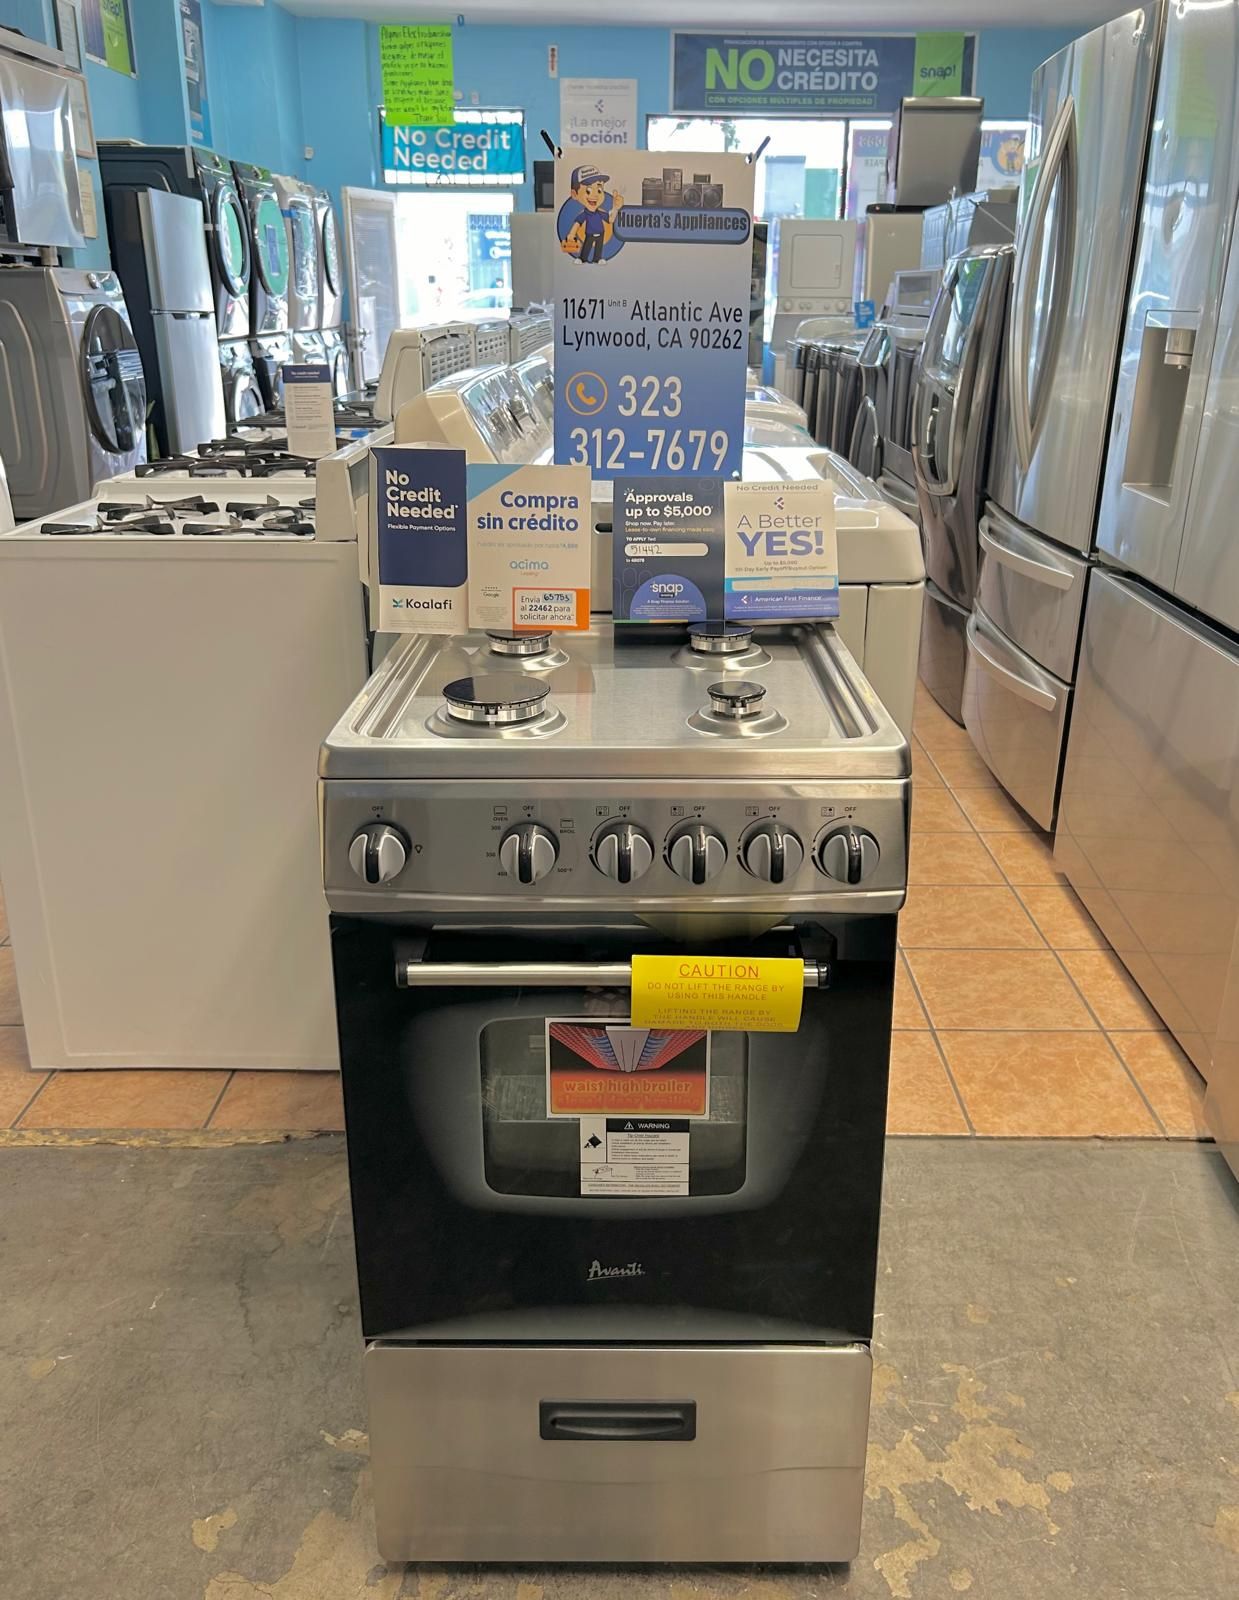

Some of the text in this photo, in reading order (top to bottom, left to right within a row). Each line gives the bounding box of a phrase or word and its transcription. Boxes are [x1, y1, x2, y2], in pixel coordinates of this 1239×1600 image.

[778, 48, 879, 67] NECESITA
[705, 48, 776, 91] NO
[920, 64, 956, 80] snap!
[777, 66, 878, 91] CRÉDITO
[708, 96, 726, 104] CON
[727, 96, 769, 105] OPCIONES
[815, 97, 825, 105] DE
[827, 97, 873, 105] PROPIEDAD
[591, 116, 627, 130] mejor
[393, 126, 511, 150] No Credit
[570, 130, 628, 146] opción!
[393, 146, 488, 171] Needed
[617, 211, 747, 232] Huerta's Appliances
[563, 298, 605, 320] 11671
[607, 299, 621, 307] Unit
[630, 300, 703, 322] Atlantic
[709, 301, 743, 323] Ave
[563, 325, 742, 351] Lynwood, CA 90262
[617, 374, 682, 418] 323
[569, 427, 729, 471] 312-7679
[385, 470, 410, 485] No
[386, 487, 441, 503] Credit
[500, 491, 579, 512] Compra
[625, 492, 694, 504] Approvals
[625, 504, 712, 519] up to $5,000
[409, 524, 434, 532] Payment
[477, 512, 579, 532] sin crédito
[737, 514, 822, 529] A Better
[630, 545, 662, 555] 51442
[736, 530, 824, 557] YES!
[510, 559, 549, 570] acima
[652, 583, 684, 596] snap
[406, 598, 452, 611] Koalafi
[529, 604, 552, 612] 22462
[680, 963, 760, 978] CAUTION
[648, 982, 661, 990] DO
[713, 983, 731, 991] THE
[735, 984, 768, 992] RANGE
[771, 984, 785, 992] BY
[564, 1079, 692, 1094] waist high broiler
[587, 1260, 646, 1281] Avanti
